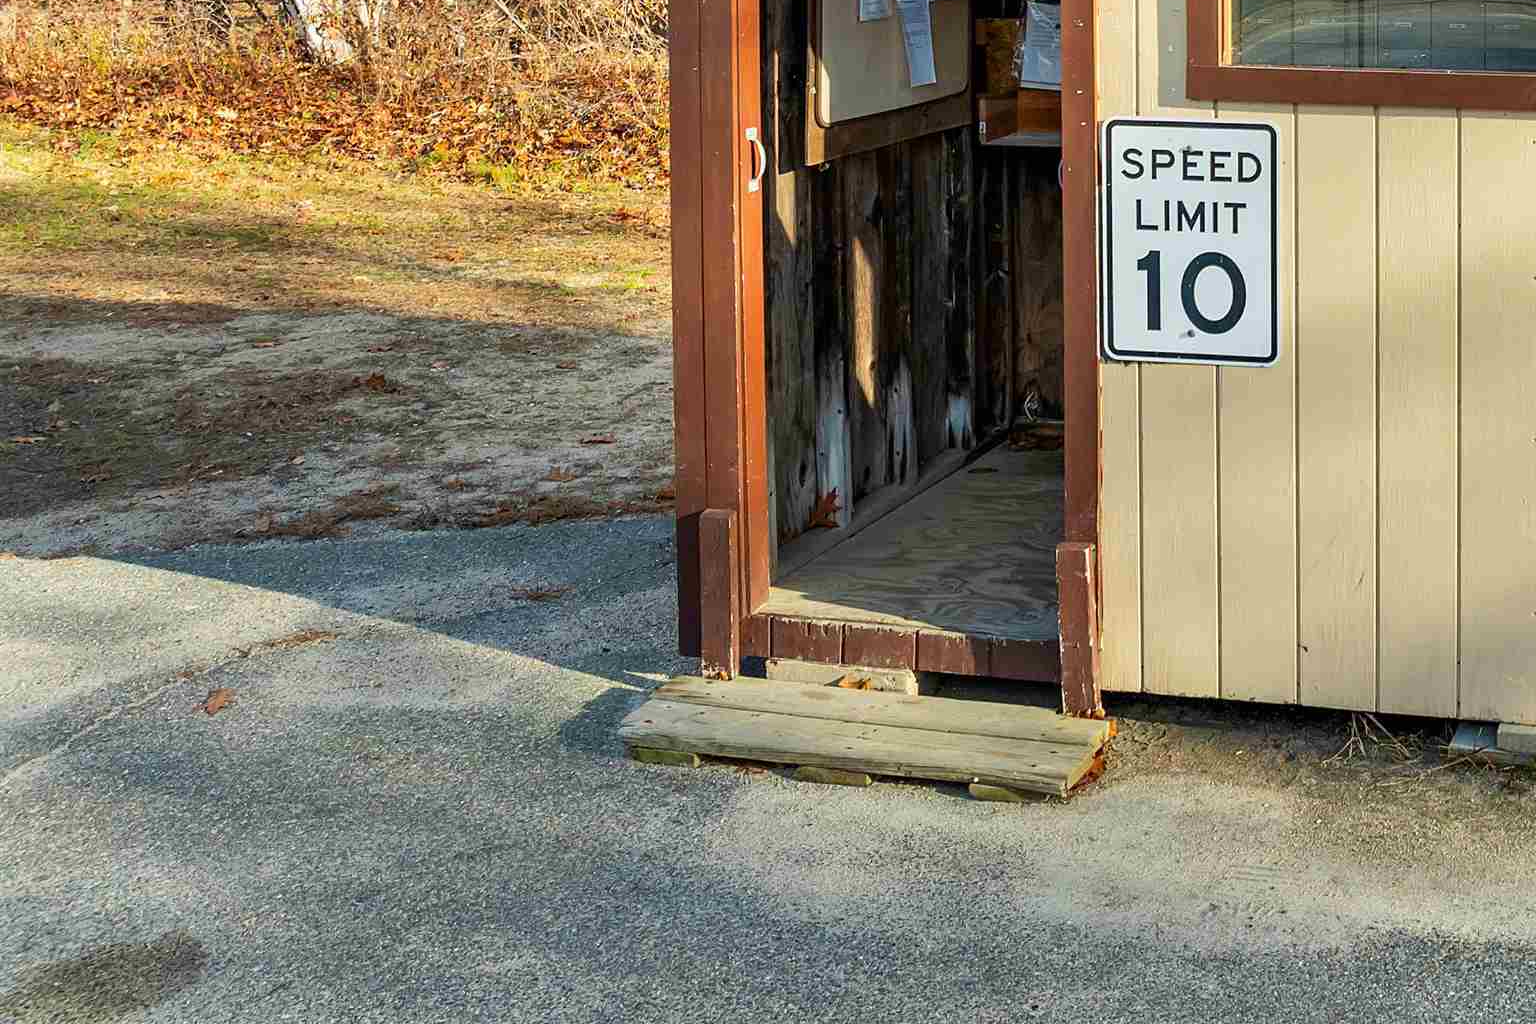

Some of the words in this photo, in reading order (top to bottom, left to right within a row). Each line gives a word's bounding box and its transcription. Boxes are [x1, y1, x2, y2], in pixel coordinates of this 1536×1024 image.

[1121, 148, 1262, 183] SPEED
[1136, 199, 1247, 234] LIMIT
[1137, 250, 1247, 334] 10
